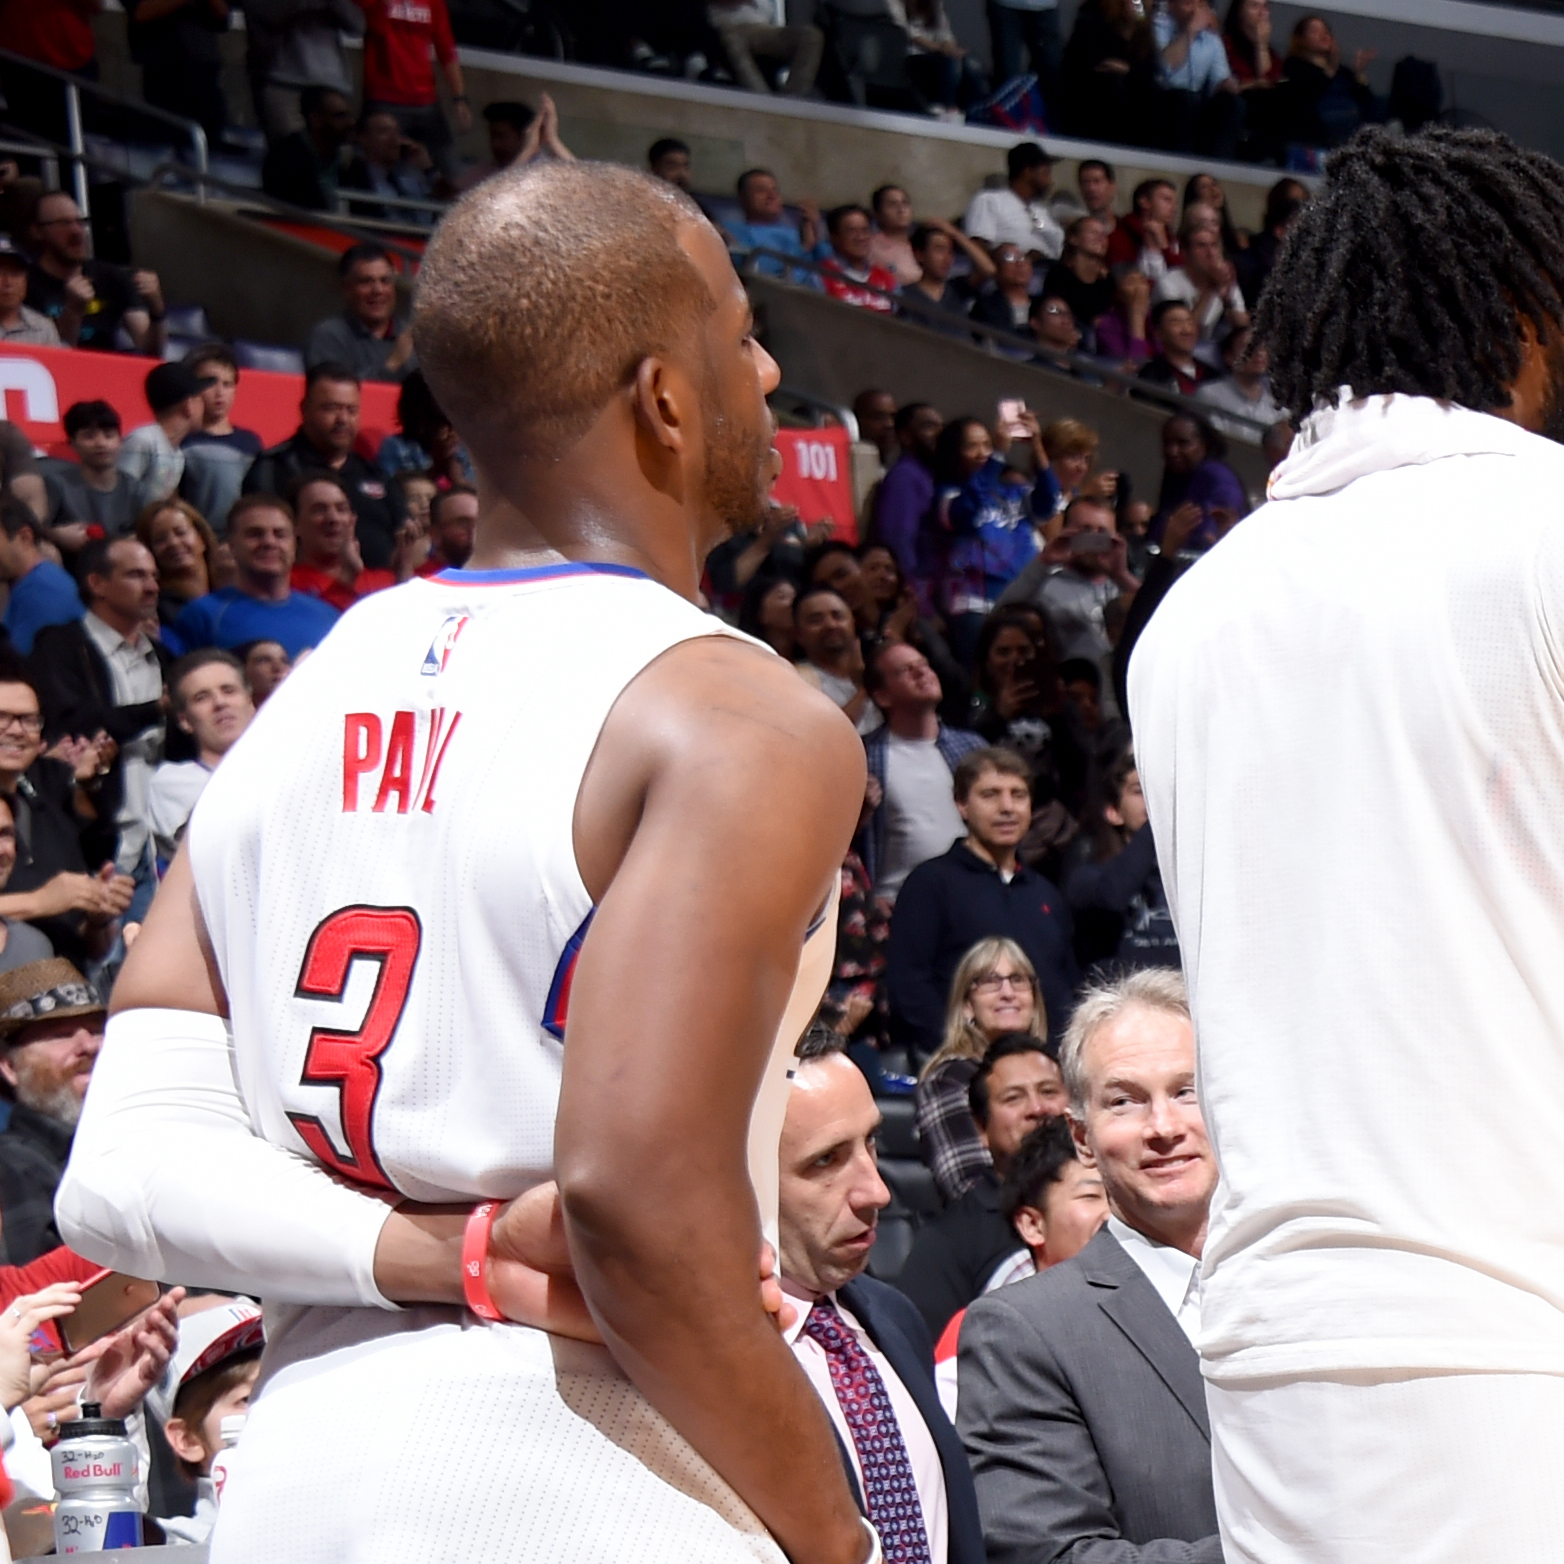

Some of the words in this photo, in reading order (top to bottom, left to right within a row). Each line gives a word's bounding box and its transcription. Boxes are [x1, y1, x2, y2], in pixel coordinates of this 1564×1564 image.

[796, 439, 838, 482] 101
[287, 904, 422, 1192] 3
[64, 1465, 90, 1480] Red
[93, 1463, 121, 1478] Bull
